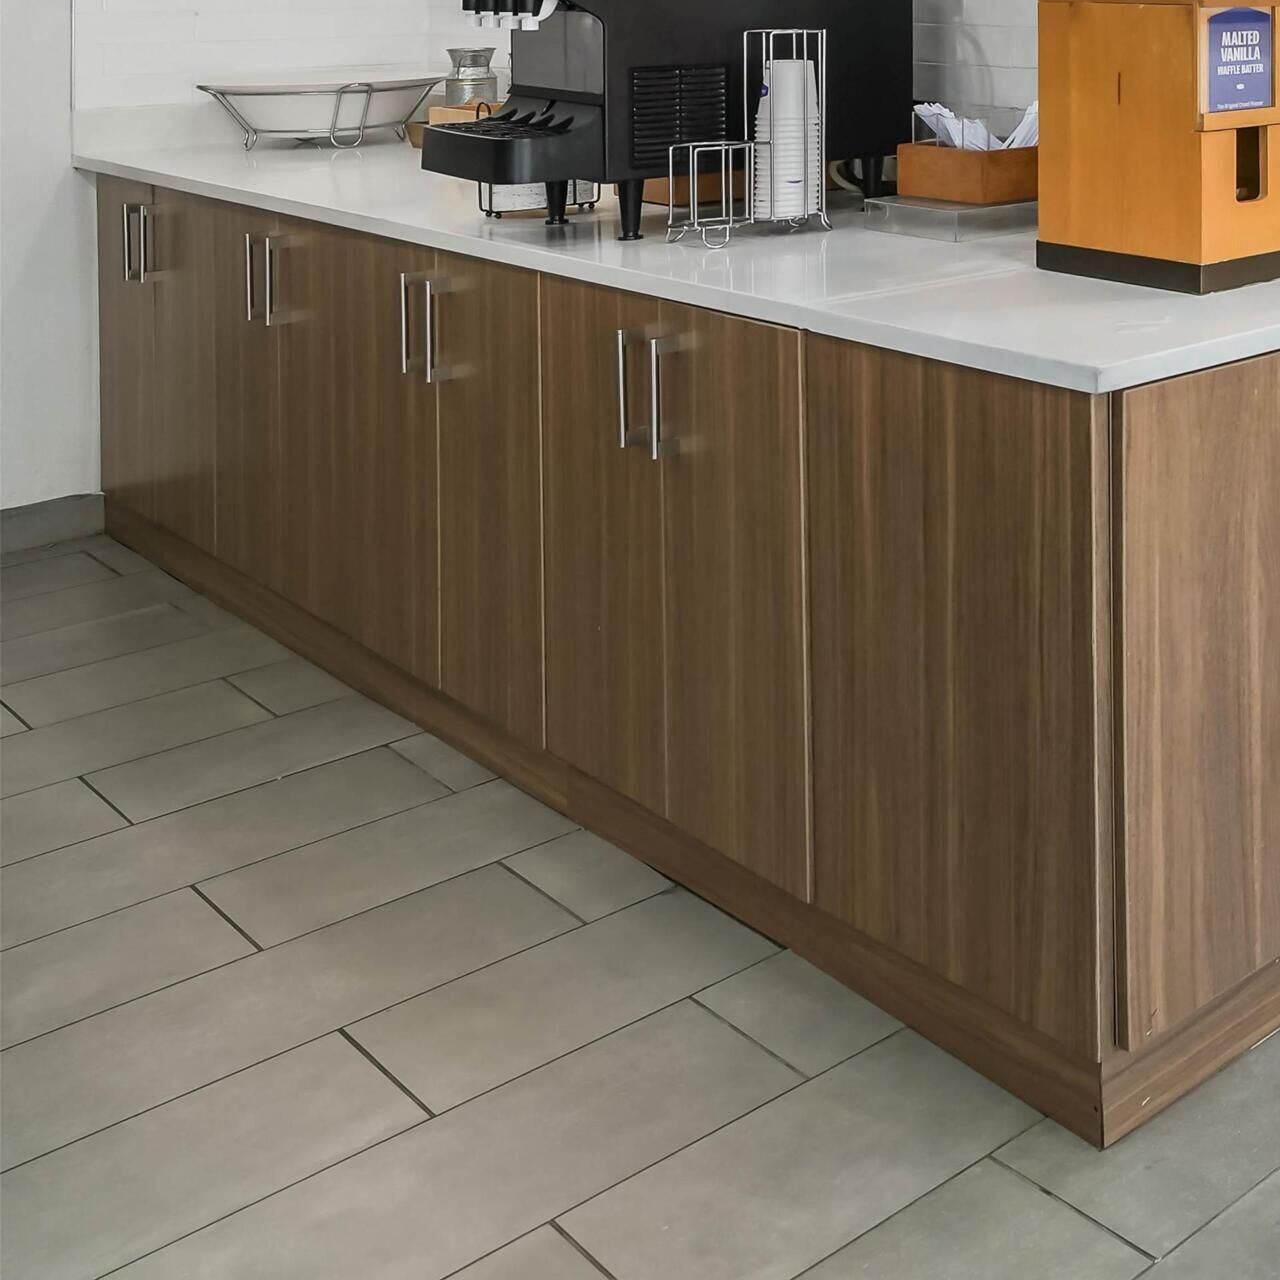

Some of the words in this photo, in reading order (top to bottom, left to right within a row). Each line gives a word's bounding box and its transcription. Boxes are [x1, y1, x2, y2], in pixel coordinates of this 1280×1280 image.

[1222, 31, 1260, 46] MALTED
[1220, 46, 1261, 62] VANILLA
[1217, 65, 1241, 75] WAFFLE
[1241, 63, 1264, 74] BATTER
